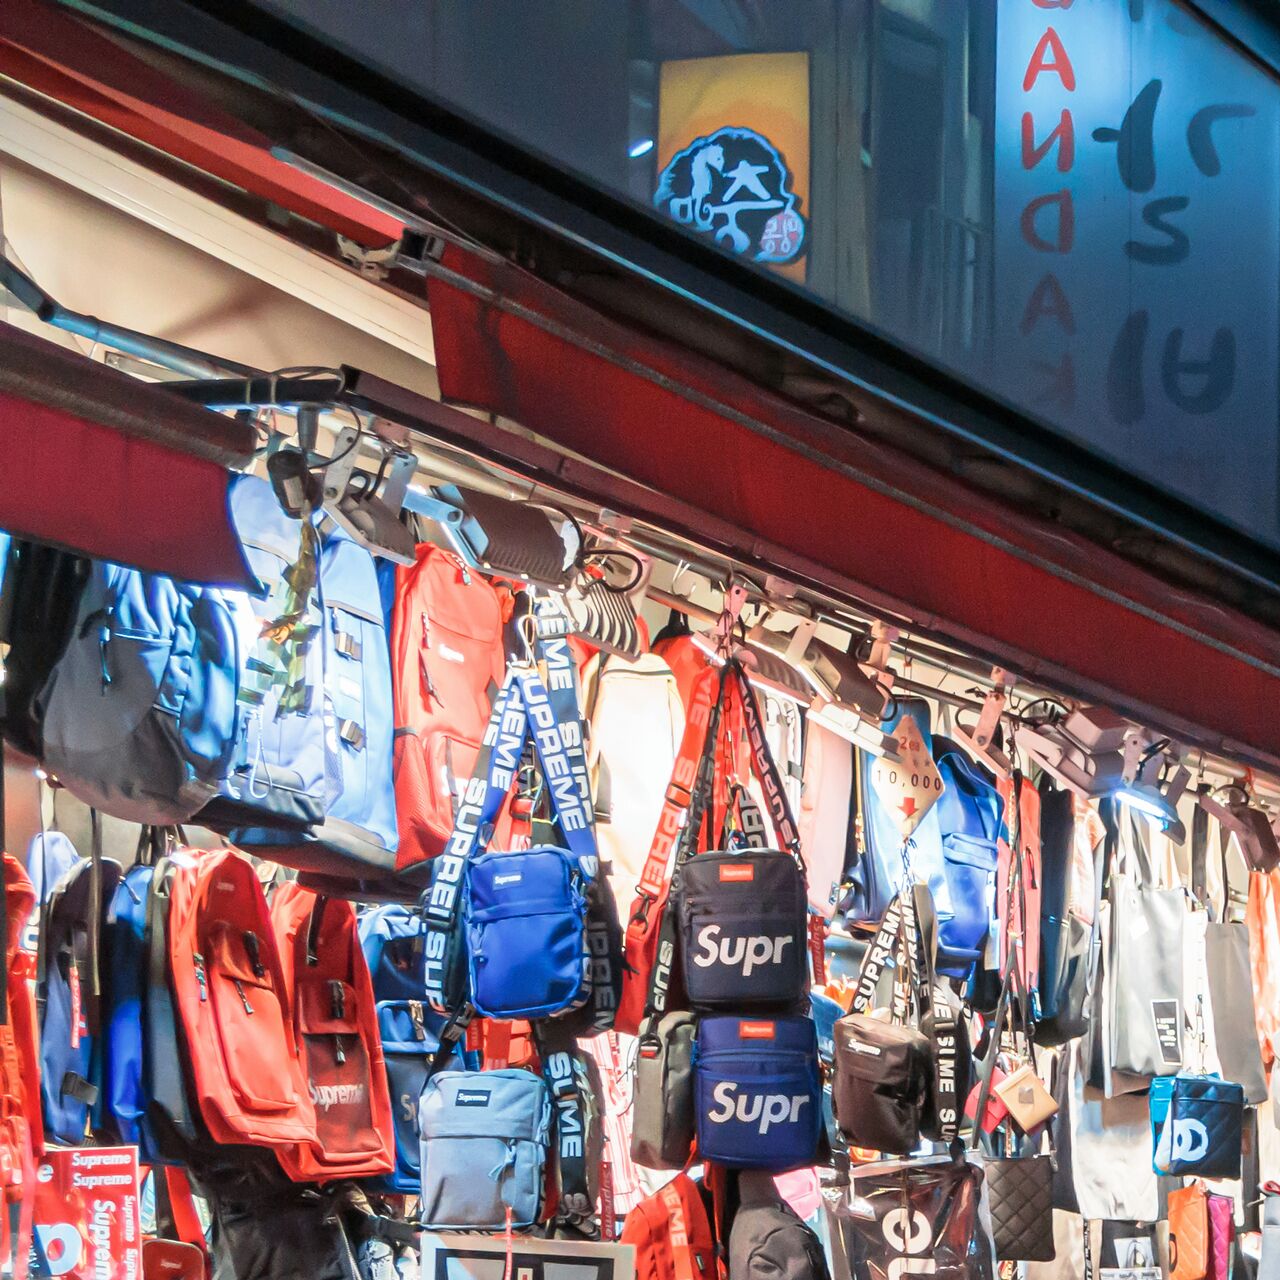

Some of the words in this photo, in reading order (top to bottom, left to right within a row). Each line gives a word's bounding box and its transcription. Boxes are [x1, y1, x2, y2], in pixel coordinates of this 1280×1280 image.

[694, 924, 793, 977] Supr
[708, 1081, 810, 1135] Supr
[72, 1152, 132, 1167] Supreme
[73, 1172, 133, 1188] Supreme
